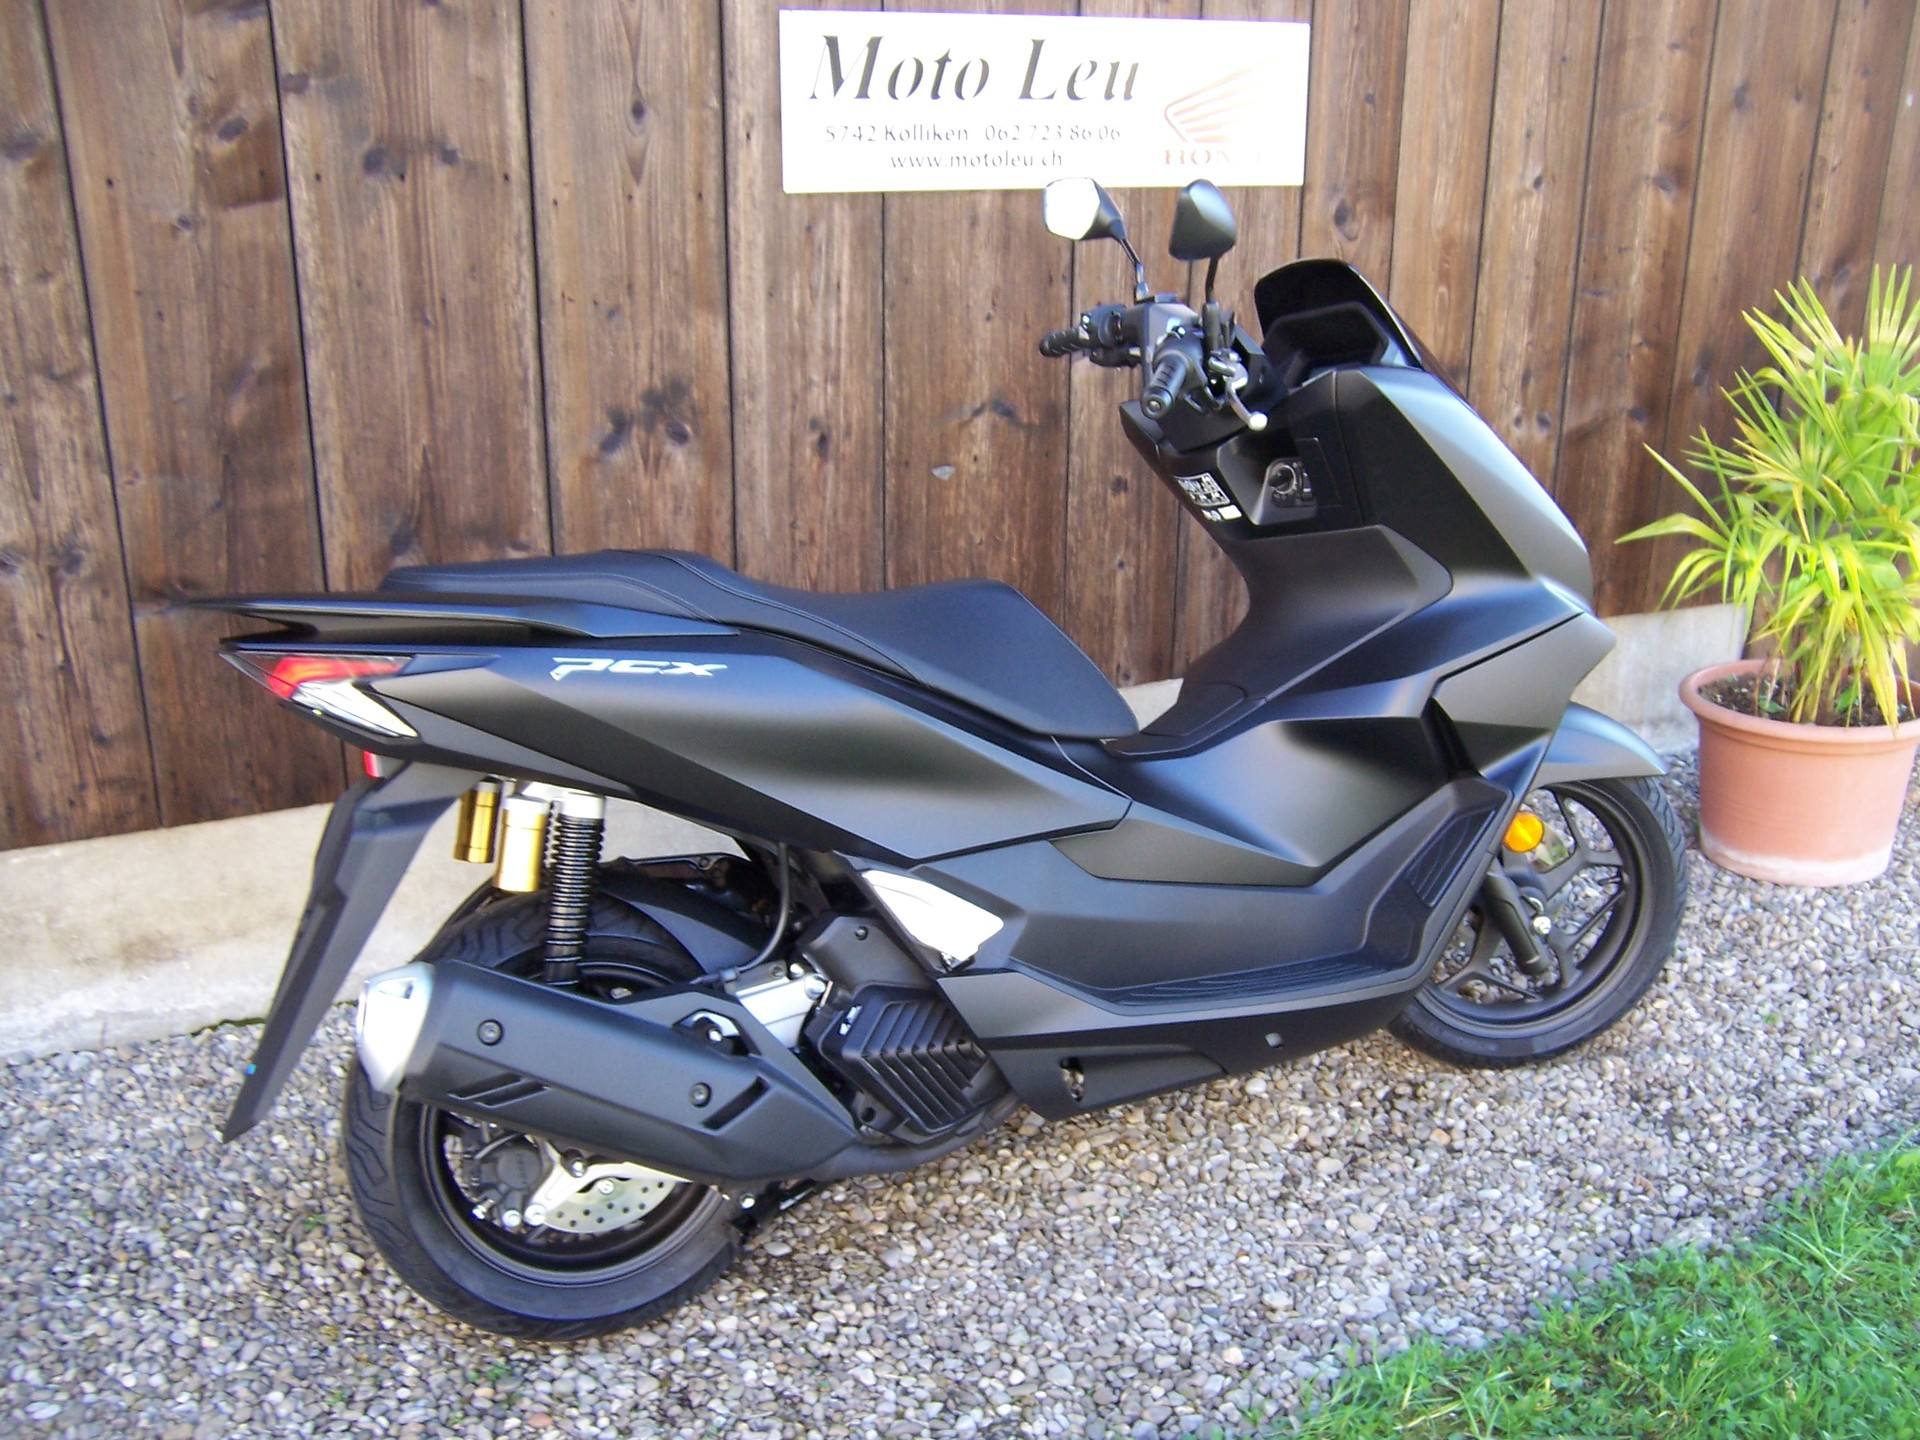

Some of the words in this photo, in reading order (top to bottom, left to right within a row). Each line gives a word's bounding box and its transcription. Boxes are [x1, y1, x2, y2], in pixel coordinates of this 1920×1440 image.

[808, 34, 990, 100] Moto
[1017, 38, 1140, 101] Leu
[825, 124, 877, 142] 5742
[984, 124, 1022, 142] 062
[1029, 124, 1062, 141] 723
[1069, 124, 1092, 141] 86
[1098, 124, 1121, 141] 06
[889, 149, 1064, 168] www.motoleu.ch
[550, 657, 728, 681] PCX
